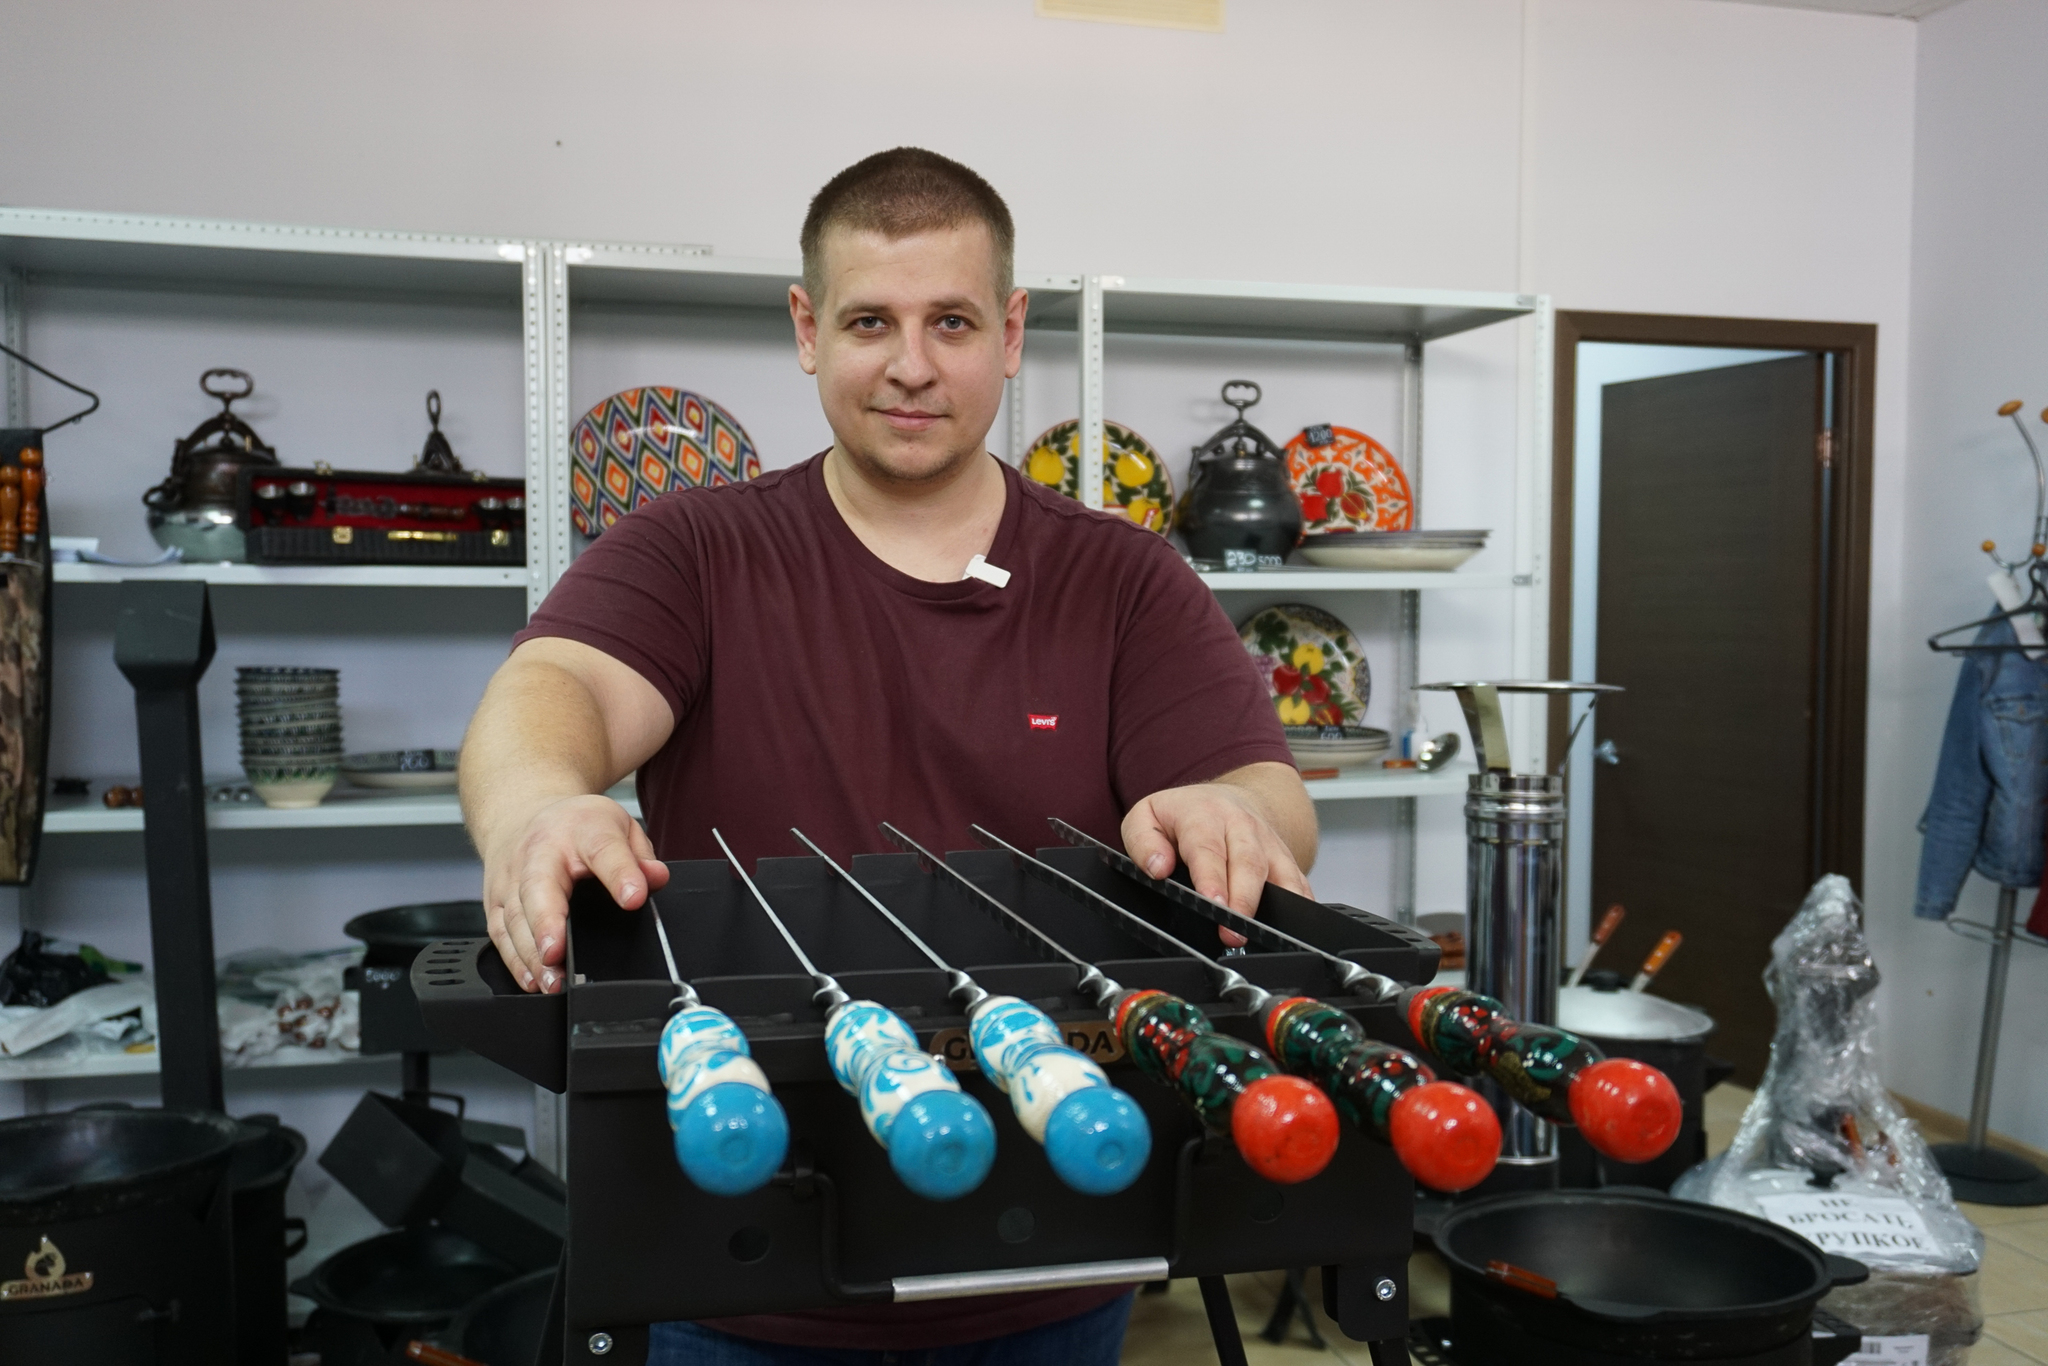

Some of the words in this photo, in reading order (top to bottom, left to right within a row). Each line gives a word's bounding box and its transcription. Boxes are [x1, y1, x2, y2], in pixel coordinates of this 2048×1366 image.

[1820, 1198, 1854, 1208] НЕ
[1787, 1211, 1913, 1229] БРОСАТЬ
[1808, 1231, 1929, 1249] РУПКОЕ
[8, 1277, 84, 1296] GRANADA
